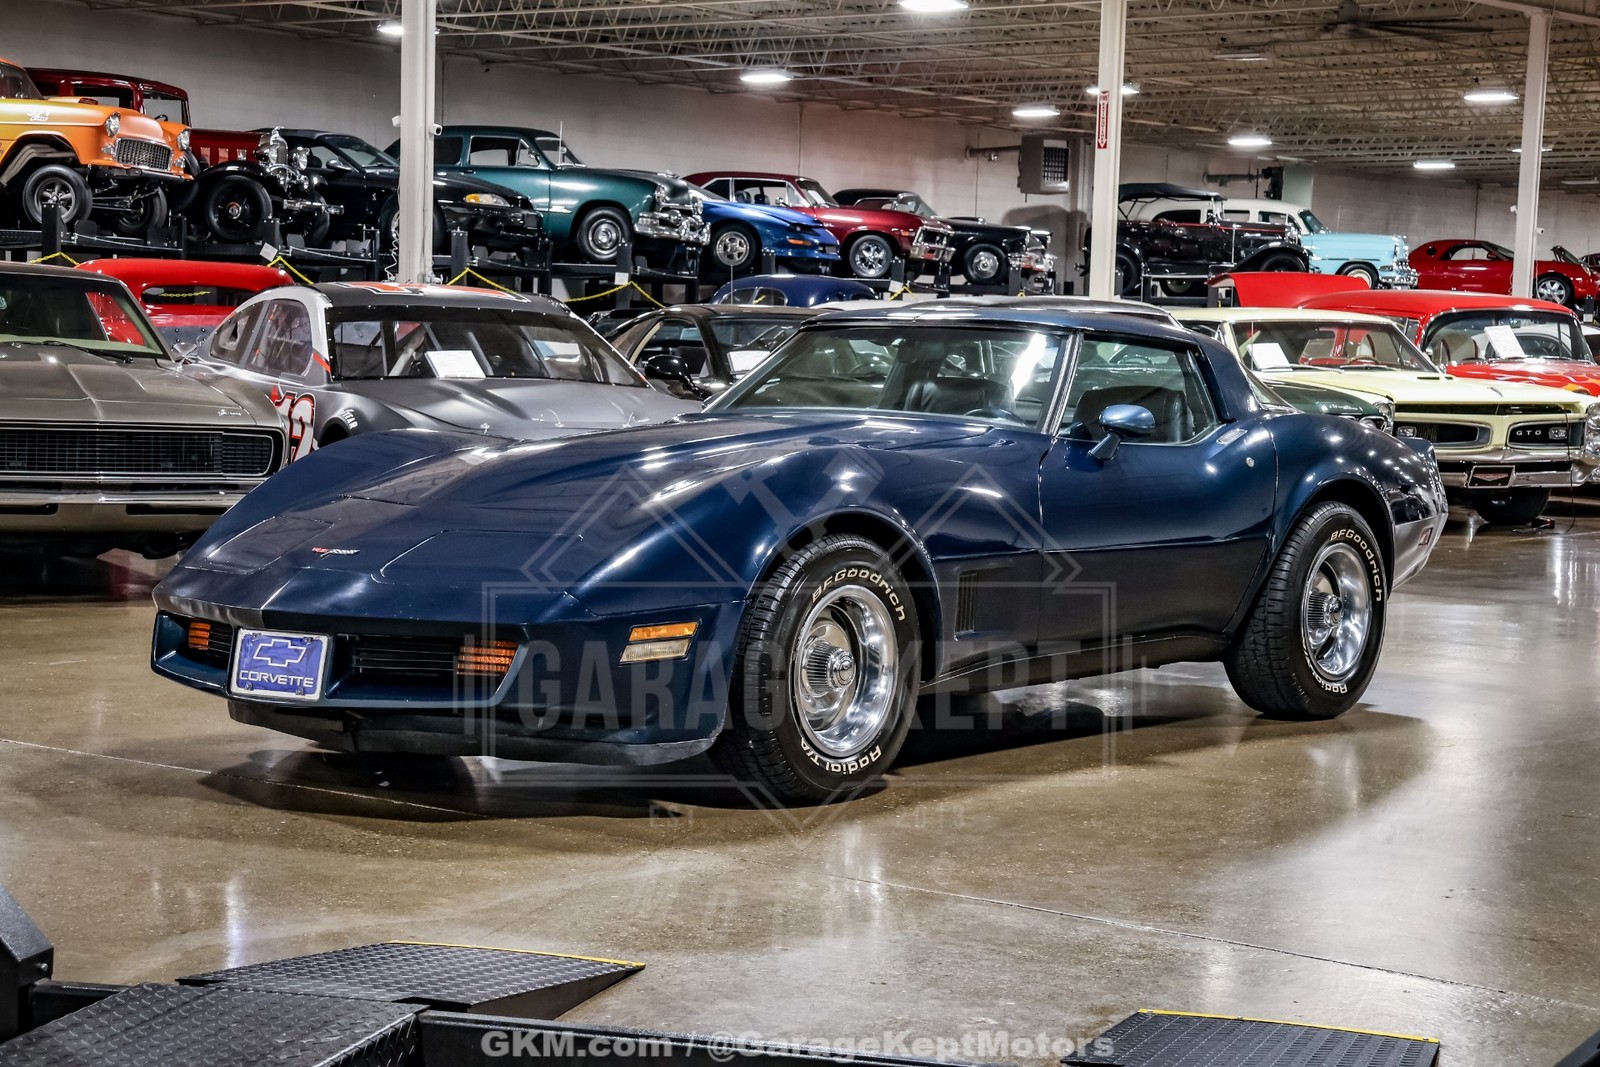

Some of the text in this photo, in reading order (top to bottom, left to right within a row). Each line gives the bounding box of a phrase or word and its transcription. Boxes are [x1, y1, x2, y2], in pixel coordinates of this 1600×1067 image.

[1329, 528, 1383, 602] BFGoodrich
[811, 567, 906, 621] BFGoodrich
[239, 670, 314, 688] CORVETTE
[800, 737, 882, 775] Radial T/A
